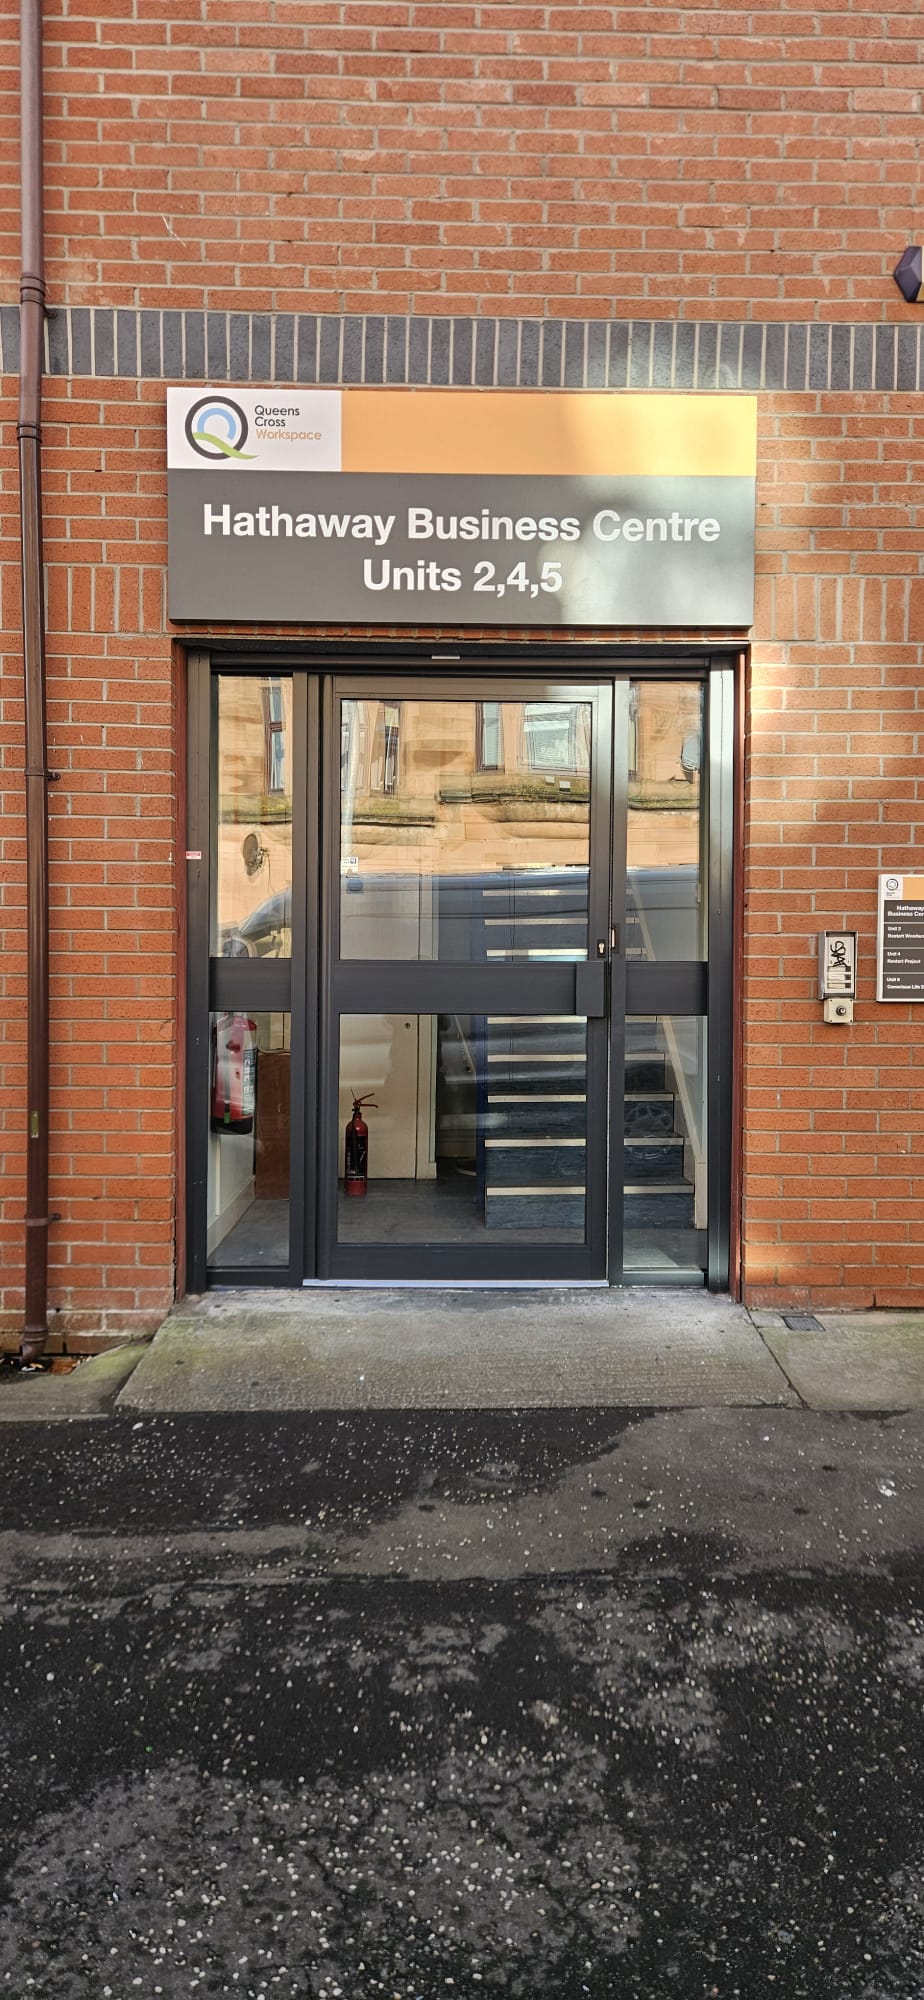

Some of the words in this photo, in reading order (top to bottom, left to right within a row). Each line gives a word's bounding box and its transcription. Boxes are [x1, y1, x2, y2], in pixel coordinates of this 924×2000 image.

[254, 404, 301, 416] Queens
[254, 416, 286, 427] Cross
[255, 428, 322, 442] Workspace
[203, 503, 396, 546] Hathaway
[407, 507, 581, 542] Business
[592, 509, 721, 542] Centre
[363, 558, 462, 592] Units
[472, 560, 563, 598] 2,4,5
